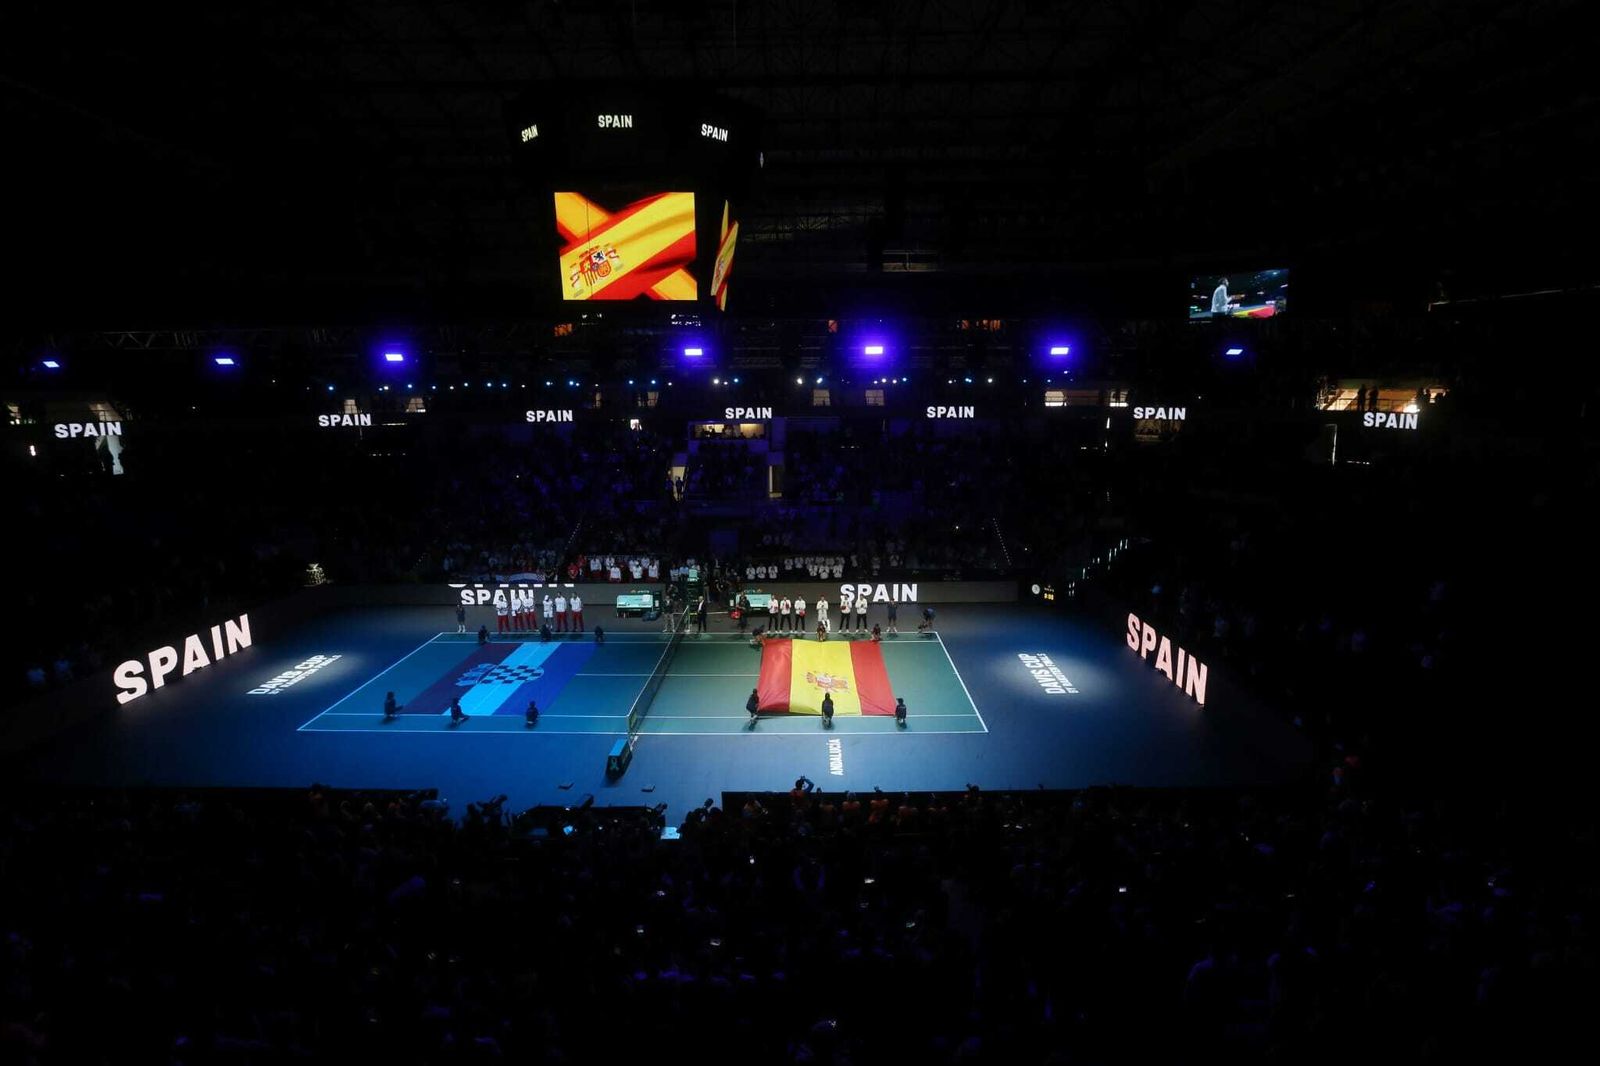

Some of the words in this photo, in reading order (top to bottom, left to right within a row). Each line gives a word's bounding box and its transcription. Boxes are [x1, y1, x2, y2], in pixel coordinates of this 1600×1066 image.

[598, 115, 632, 128] SPAIN
[521, 124, 538, 142] SPAIN
[701, 123, 728, 142] SPAIN
[318, 413, 372, 427] SPAIN
[525, 409, 574, 422] SPAIN
[725, 407, 773, 420] SPAIN
[926, 406, 975, 419] SPAIN
[1133, 406, 1187, 420] SPAIN
[1363, 412, 1419, 430] SPAIN
[54, 420, 122, 439] SPAIN
[840, 583, 918, 602] SPAIN
[114, 613, 253, 705] SPAIN
[1018, 653, 1045, 668] CUP
[1126, 612, 1208, 706] SPAIN
[246, 670, 303, 695] DAVIS
[294, 654, 327, 670] CUP
[1029, 668, 1067, 694] DAVIS
